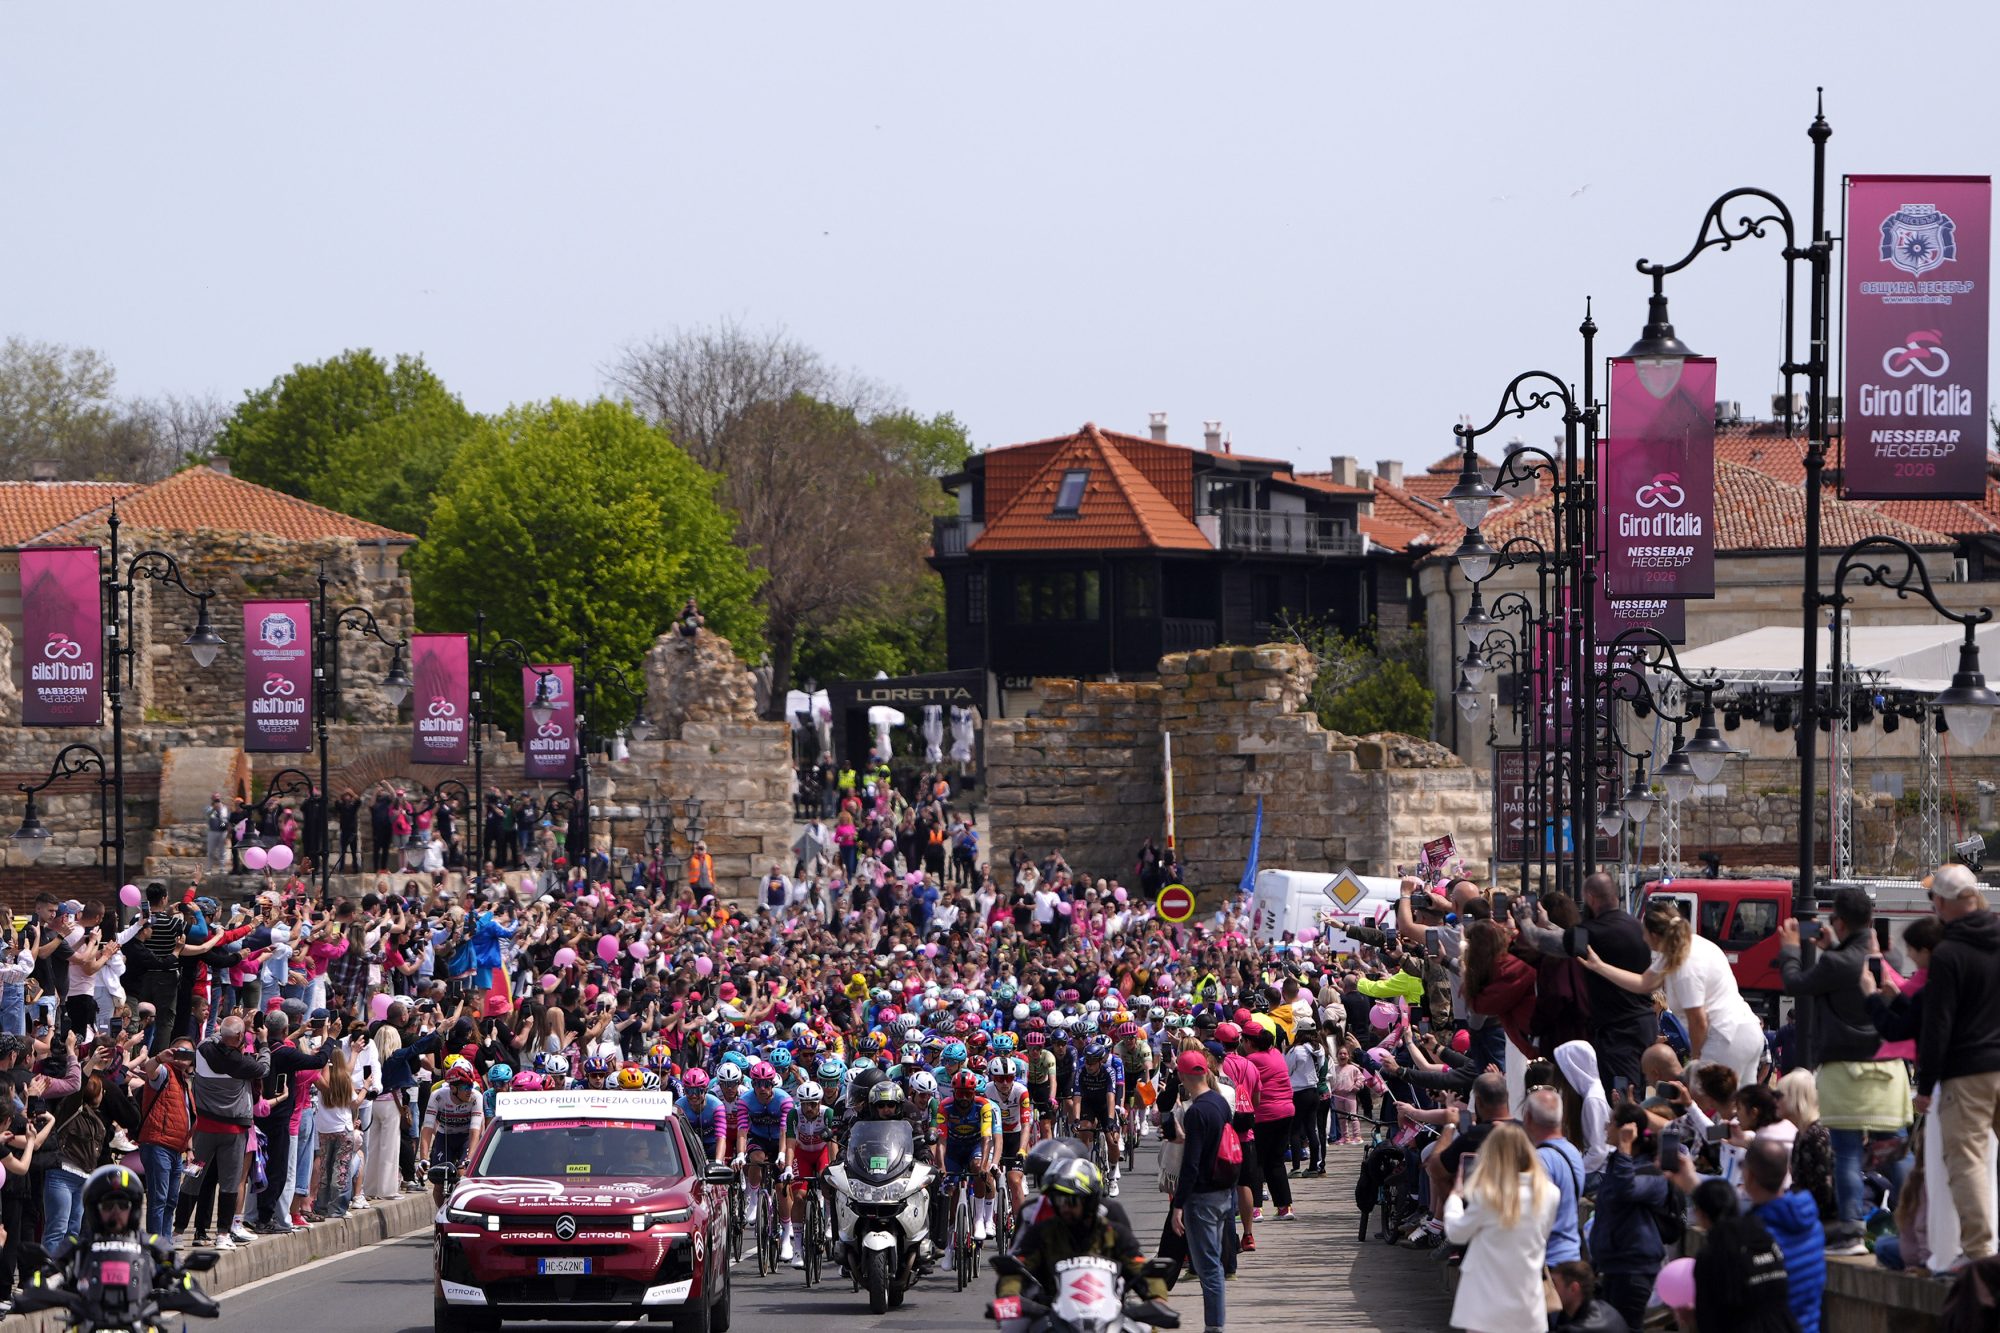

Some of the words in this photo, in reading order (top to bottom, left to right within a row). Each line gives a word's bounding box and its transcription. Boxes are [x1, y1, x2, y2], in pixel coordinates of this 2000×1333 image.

[1860, 281, 1915, 294] ОБЩИНА
[1917, 281, 1975, 293] НЕСЕБЪР
[1859, 384, 1902, 416] Giro
[1905, 384, 1972, 416] d'Italia
[1870, 429, 1960, 443] NESSEBAR
[1874, 444, 1956, 458] НЕСЕБЪР
[1893, 463, 1936, 477] 2026
[1619, 512, 1650, 537] Giro
[1653, 512, 1702, 537] d'Italia
[1628, 546, 1694, 557] NESSEBAR
[1631, 557, 1691, 568] НЕСЕБЪР
[1646, 571, 1677, 582] 2026
[1611, 600, 1667, 609] NESSEBAR
[1614, 609, 1665, 618] НЕСЕБЪР
[856, 687, 972, 702] LORETTA
[499, 1098, 510, 1106] IO
[513, 1097, 547, 1105] SONO
[584, 1096, 629, 1104] VENEZIA
[632, 1097, 667, 1105] GIULIA
[91, 1241, 141, 1254] SUZUKI
[1055, 1256, 1118, 1273] SUZUKI
